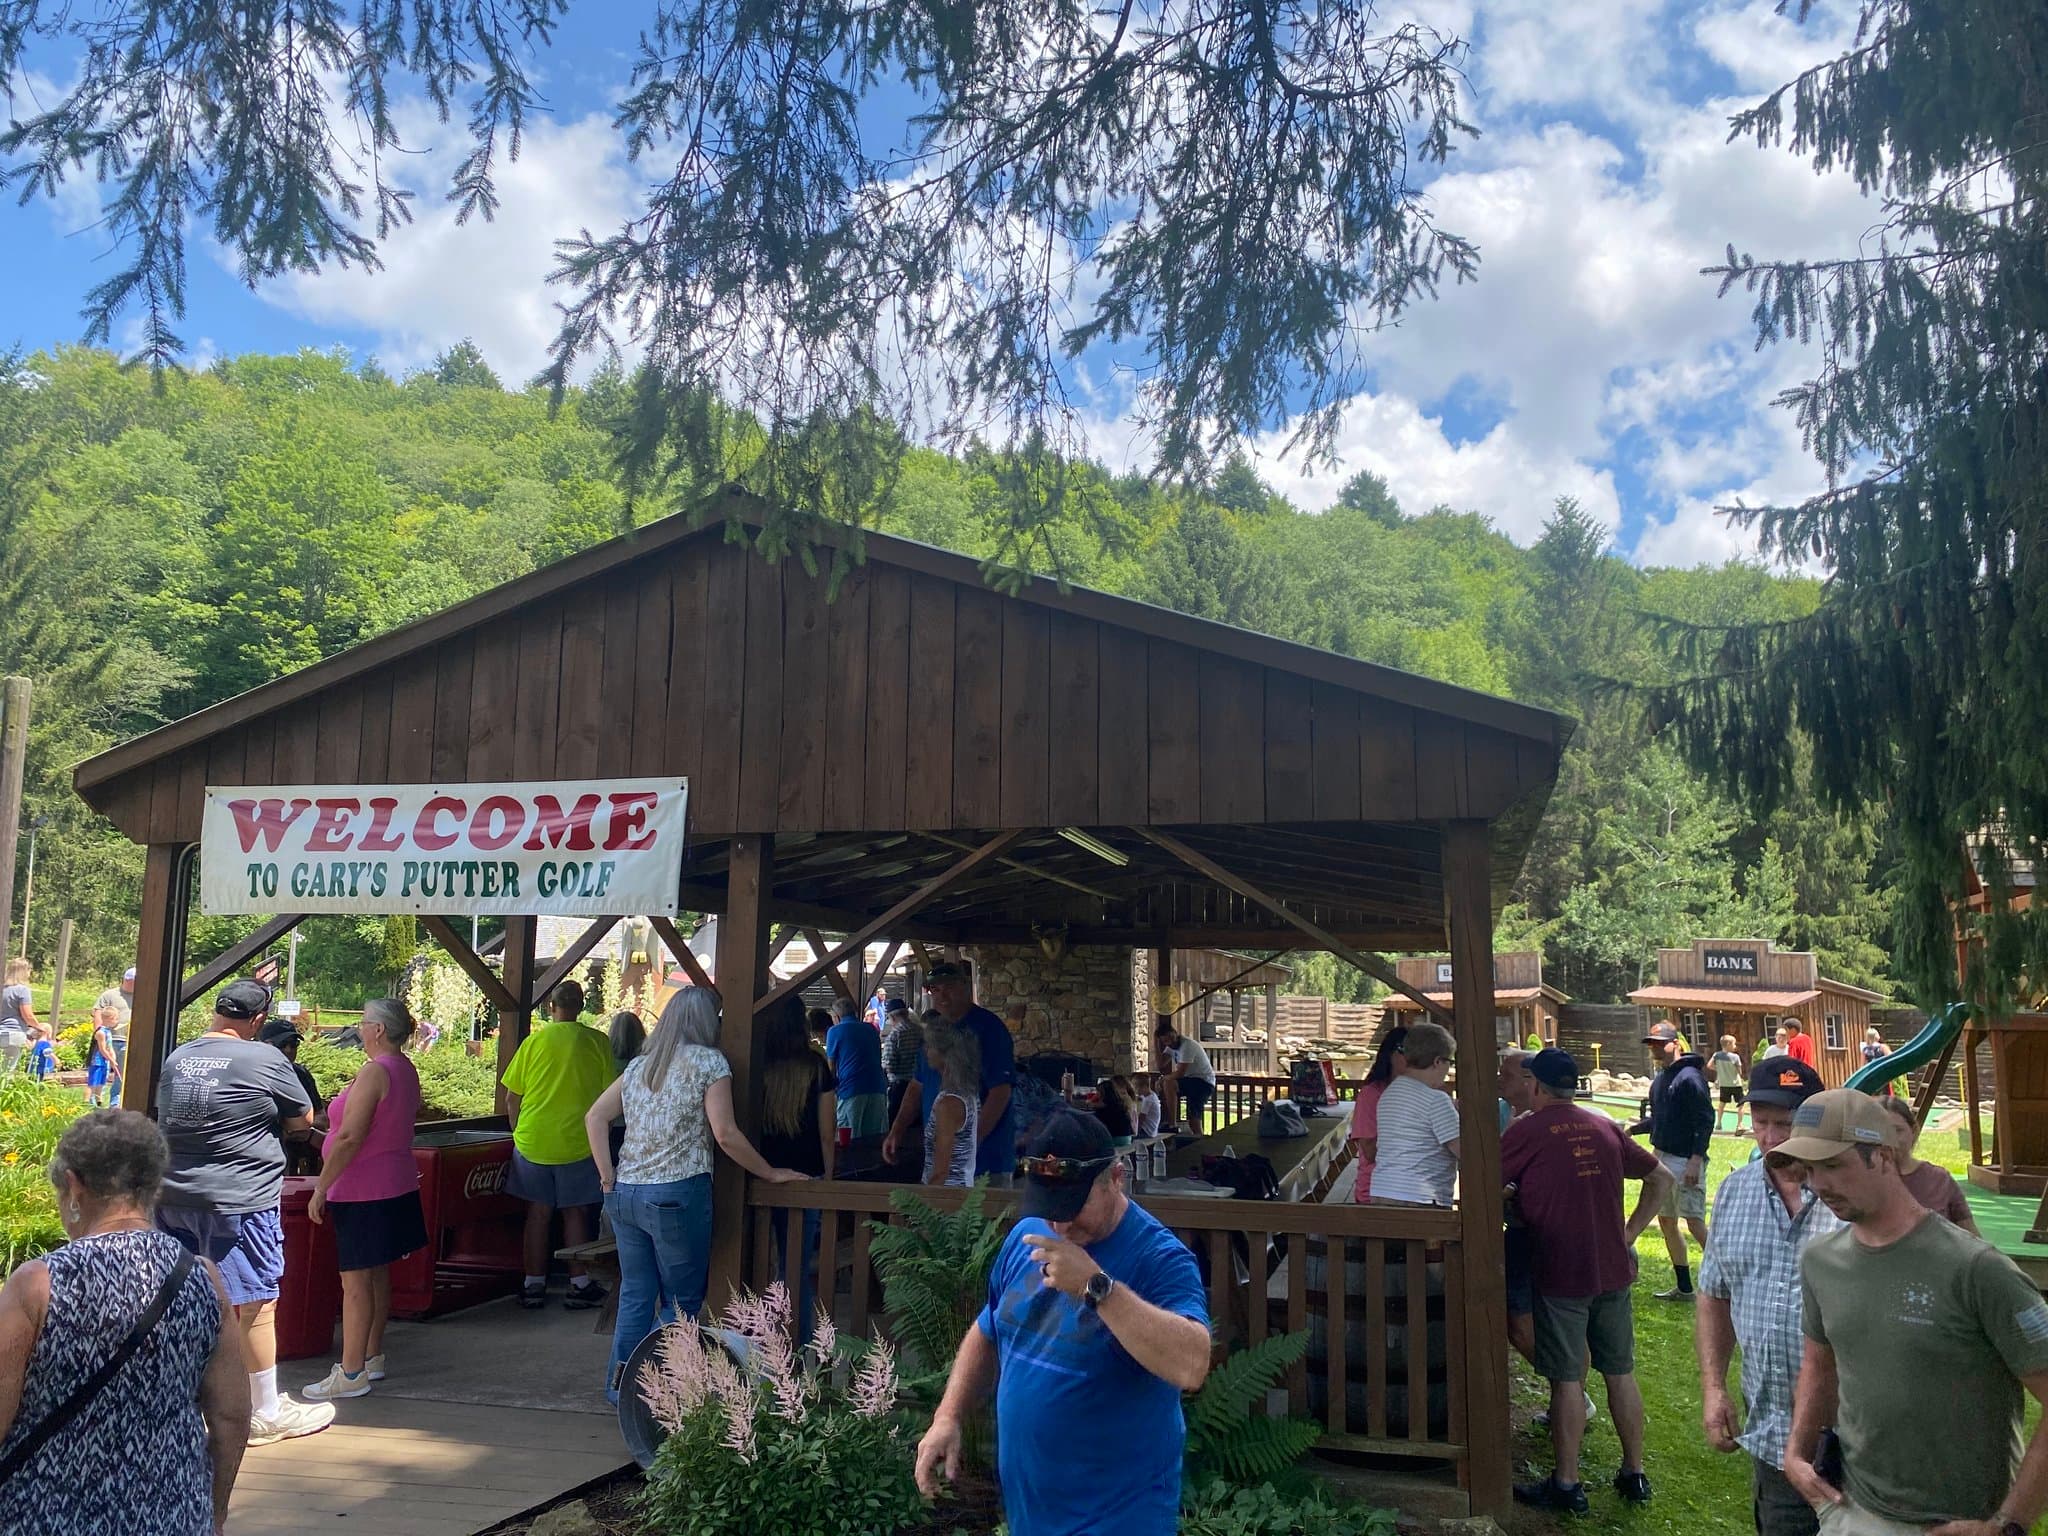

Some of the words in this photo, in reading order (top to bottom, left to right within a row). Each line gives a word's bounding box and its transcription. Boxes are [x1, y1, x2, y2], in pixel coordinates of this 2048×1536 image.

[227, 792, 658, 853] WELCOME
[247, 862, 278, 898] TO
[291, 861, 388, 898] GARY'S
[401, 860, 521, 898] PUTTER
[538, 860, 616, 897] GOLF
[1707, 956, 1754, 970] BANK
[176, 1058, 230, 1070] SCOTTISH
[181, 1067, 210, 1078] RITE
